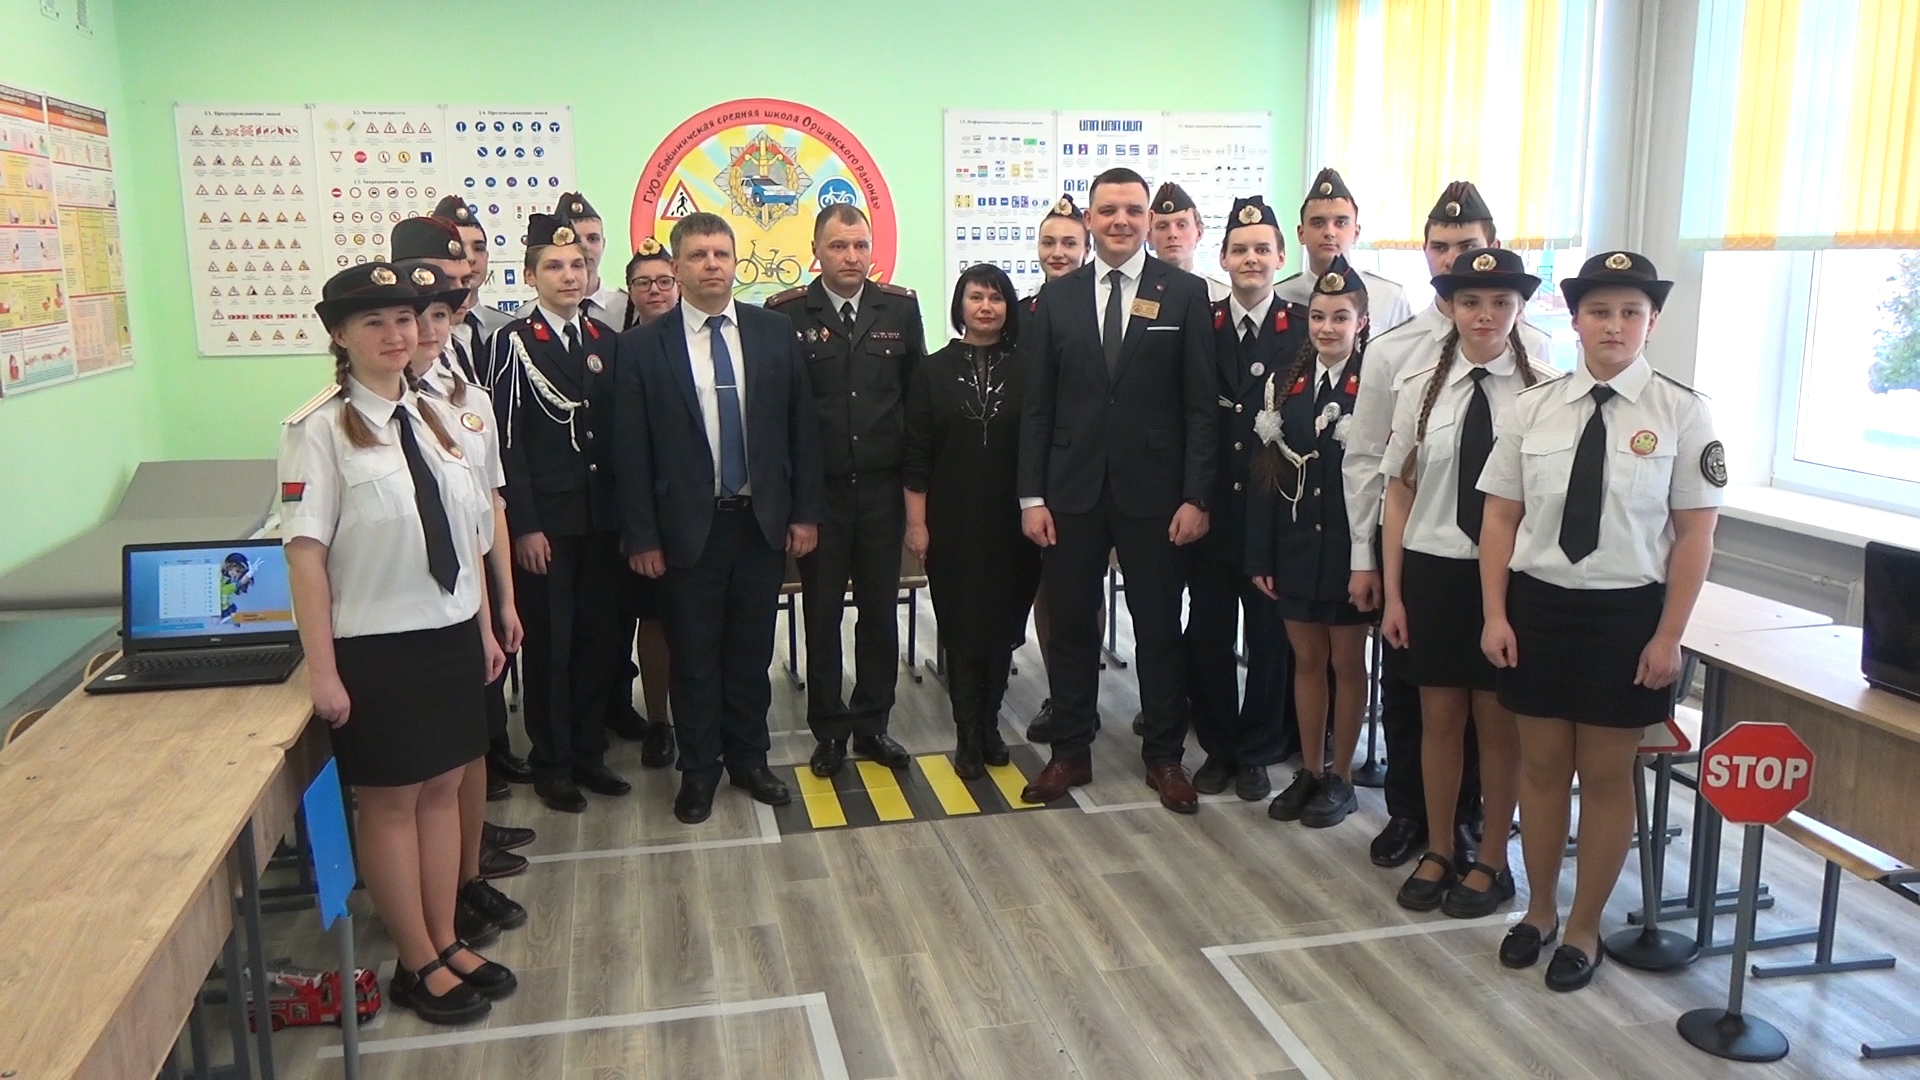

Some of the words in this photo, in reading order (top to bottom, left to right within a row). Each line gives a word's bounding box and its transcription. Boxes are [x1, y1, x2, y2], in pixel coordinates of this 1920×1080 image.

[643, 178, 661, 204] ГУО
[657, 119, 715, 178] «Бабиничская
[717, 109, 760, 125] средняя
[764, 110, 799, 123] школа
[802, 116, 859, 165] Оршанского
[1706, 754, 1808, 790] STOP
